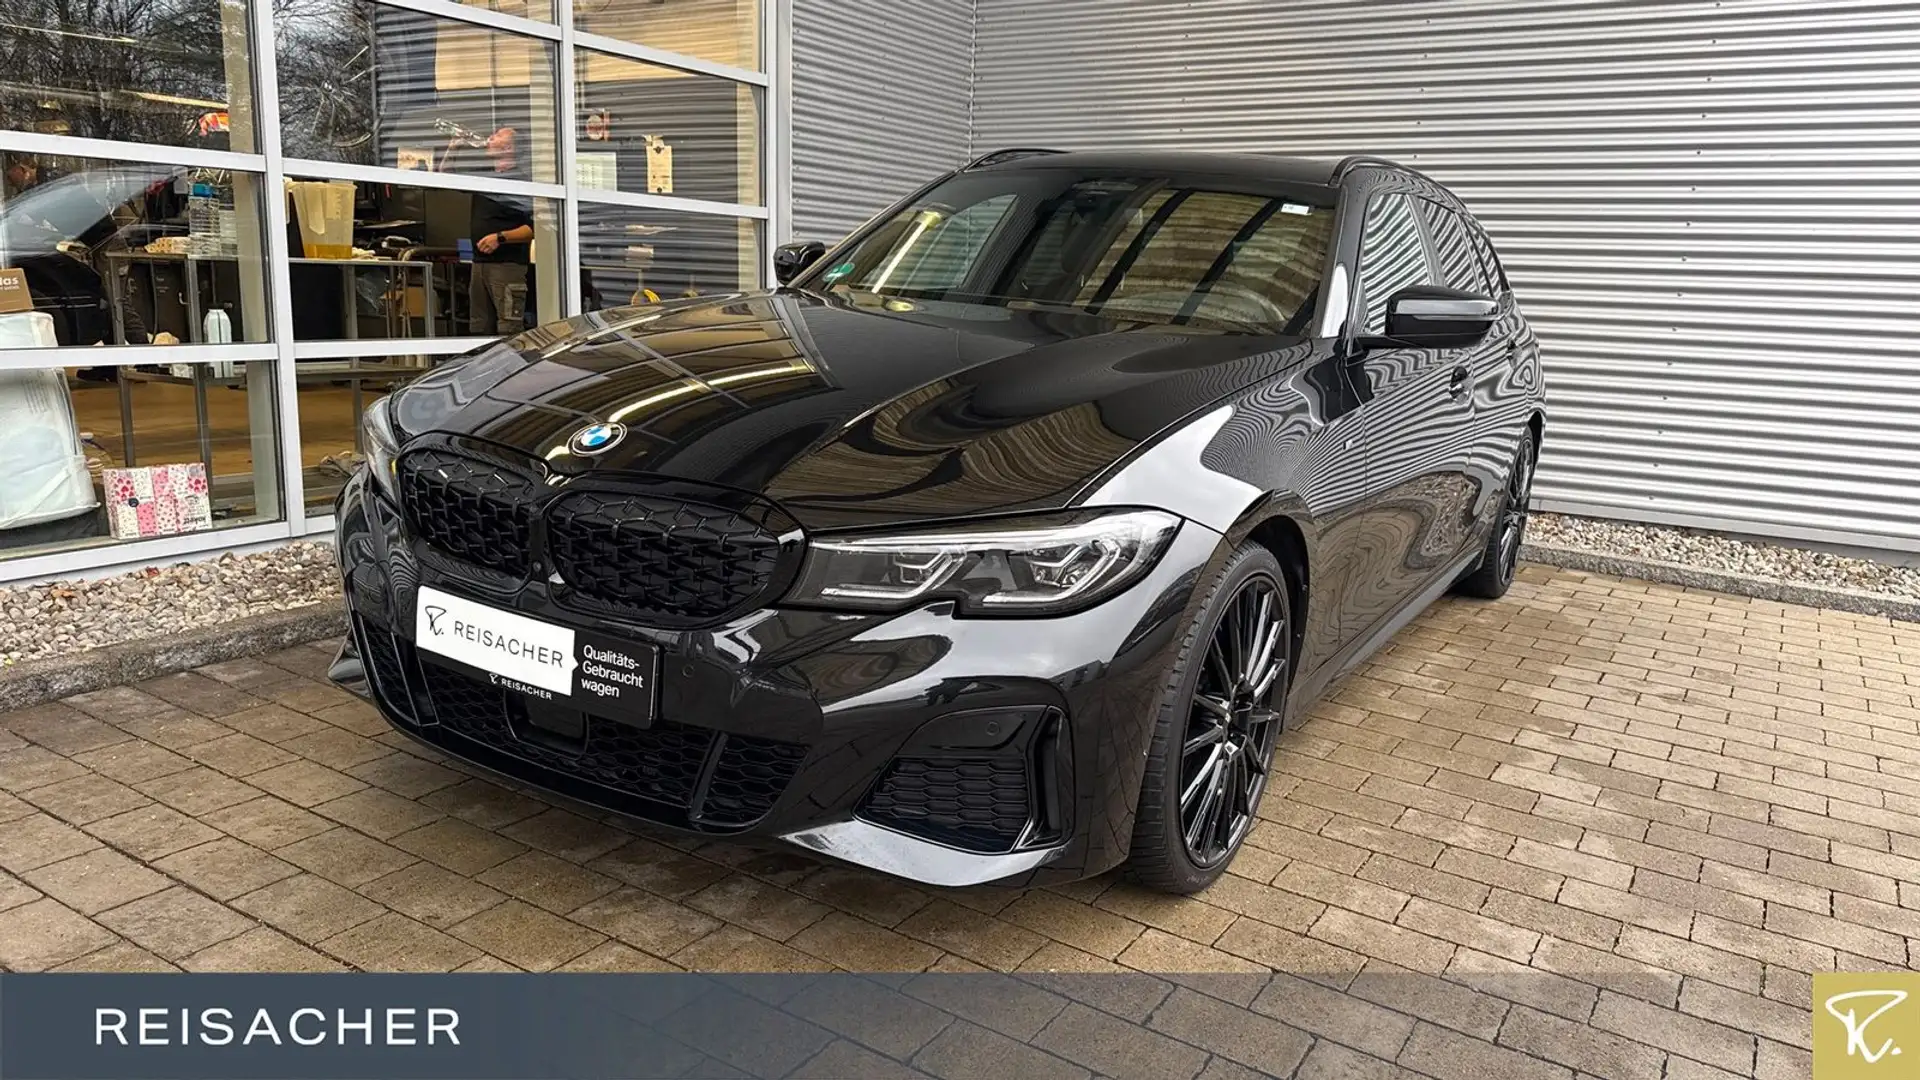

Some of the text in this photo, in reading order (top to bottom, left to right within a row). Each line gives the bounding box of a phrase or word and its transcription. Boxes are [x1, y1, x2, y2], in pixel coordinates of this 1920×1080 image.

[454, 620, 564, 668] REISACHER
[583, 645, 640, 670] Qualitäts-
[581, 677, 620, 699] wagen
[582, 662, 644, 689] Gebraucht
[501, 678, 552, 701] REISACHER
